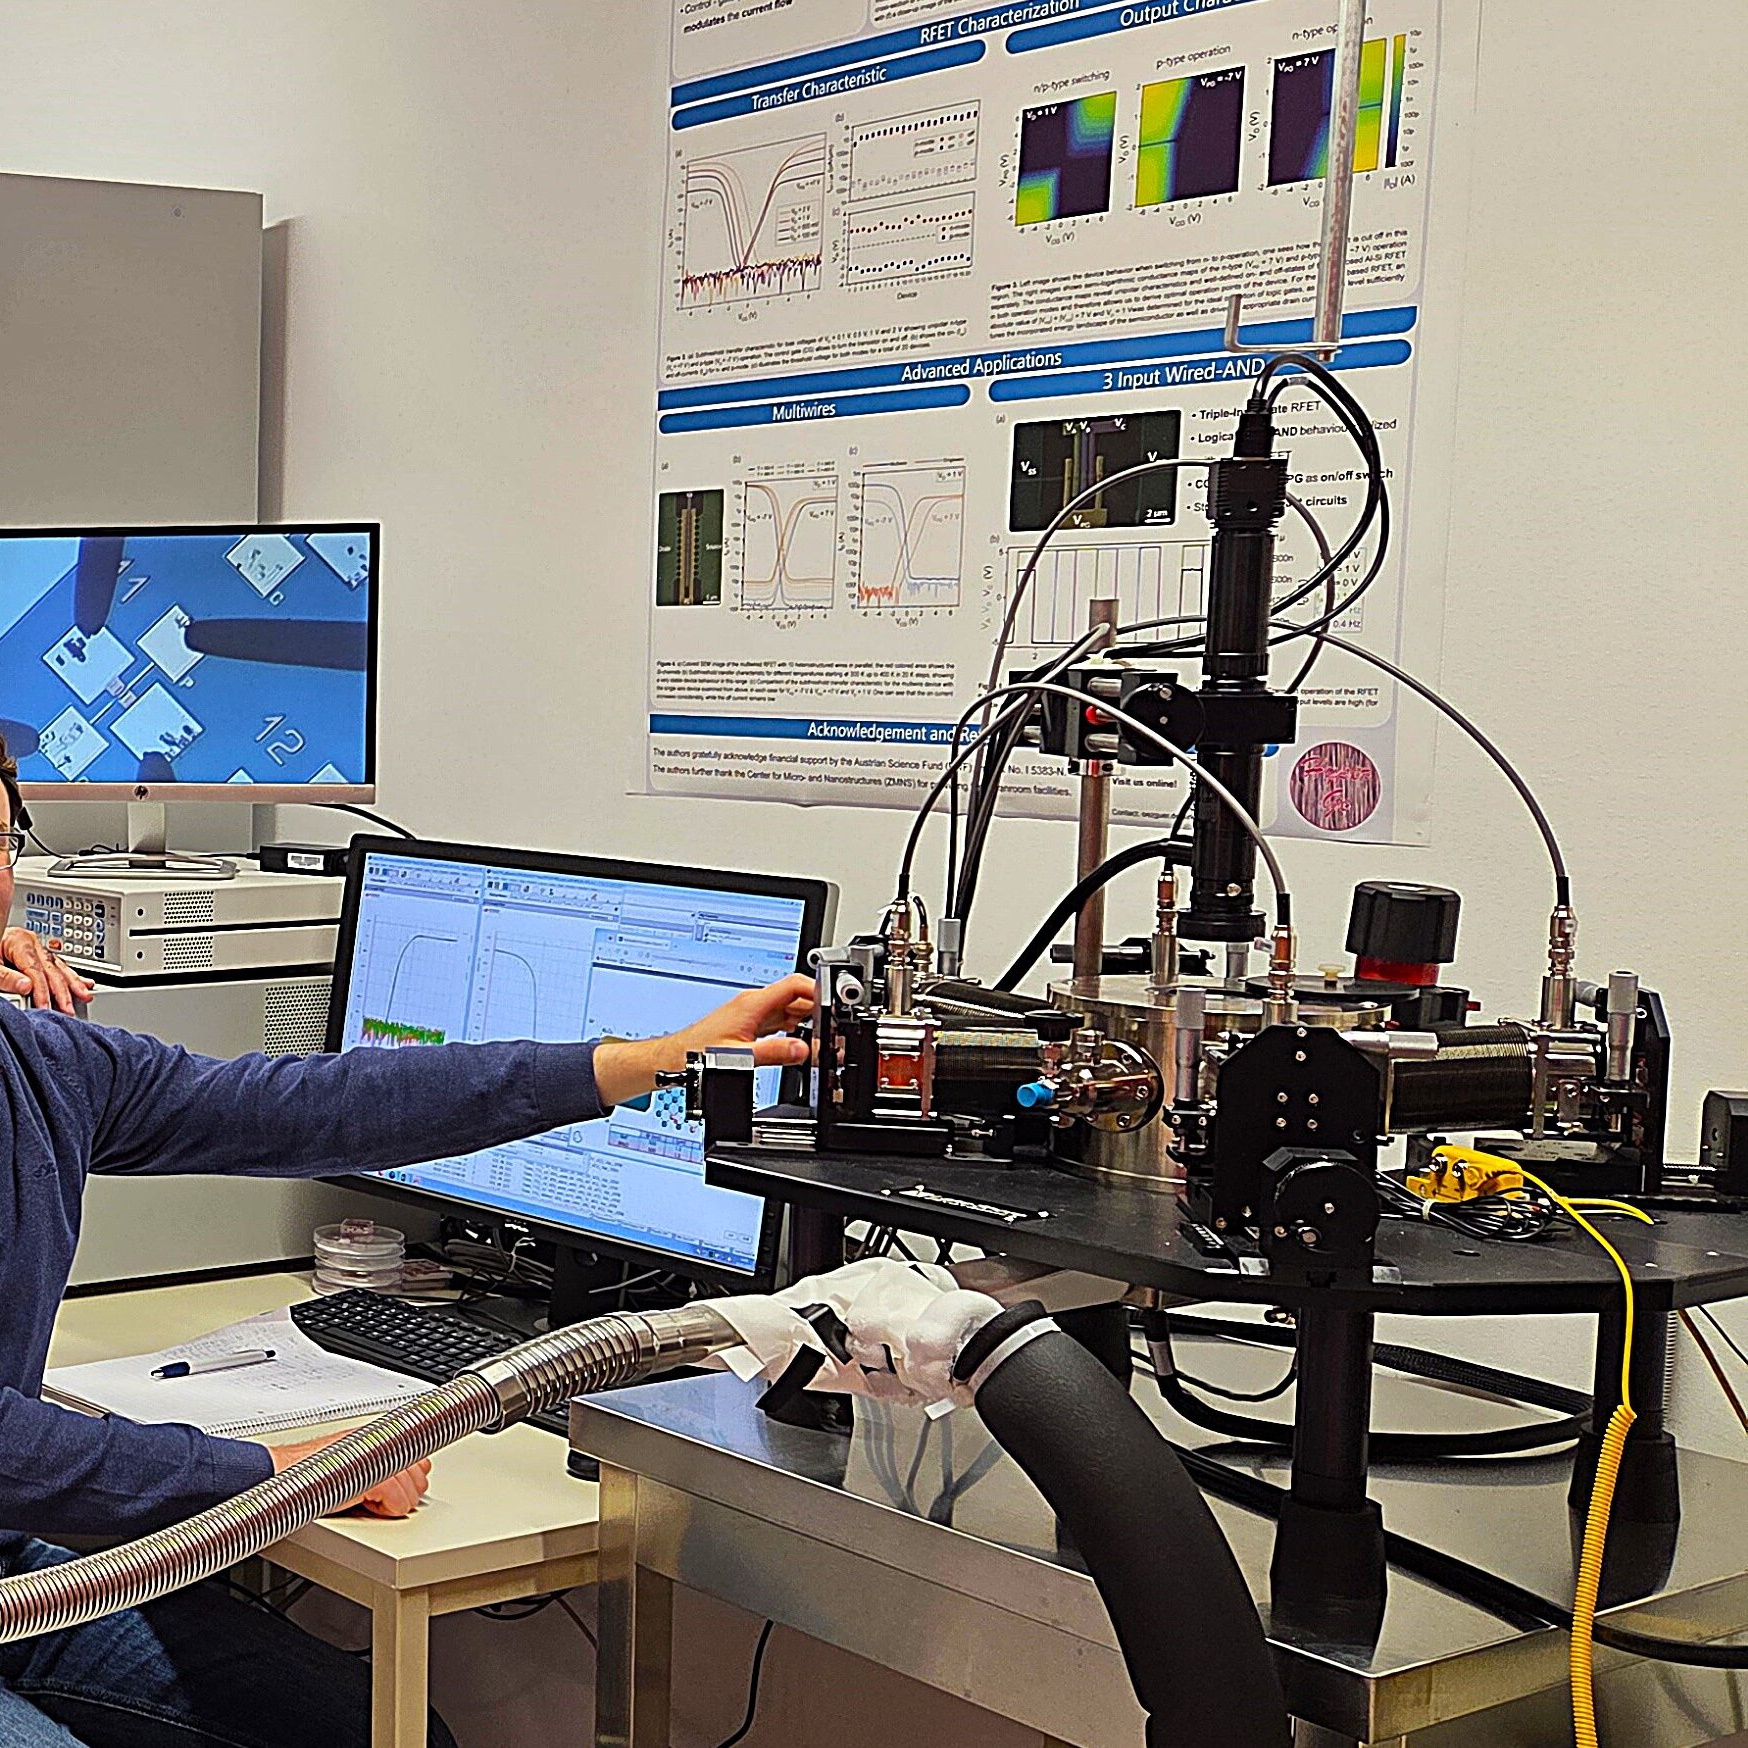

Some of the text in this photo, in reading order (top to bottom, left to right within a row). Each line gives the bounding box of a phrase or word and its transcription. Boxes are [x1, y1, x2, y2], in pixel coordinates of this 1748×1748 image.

[920, 21, 954, 44] RFET
[957, 0, 1079, 33] Characterization
[1120, 3, 1179, 27] Output
[1292, 27, 1324, 41] n-type
[1156, 45, 1230, 70] p-type operation
[1311, 56, 1319, 66] V
[1071, 71, 1110, 87] switching
[1235, 71, 1242, 81] V
[752, 66, 887, 110] Transfer Characteristic
[901, 350, 1062, 381] Advanced Applications
[1102, 357, 1265, 389] 3 Input Wired-AND
[772, 401, 835, 421] Multiwires
[1271, 404, 1288, 413] ate
[1290, 400, 1322, 412] RFET
[1197, 430, 1234, 444] Logica
[1299, 421, 1348, 436] behaviou
[1305, 474, 1317, 483] as
[1320, 470, 1354, 482] on/off
[1354, 468, 1393, 480] swch
[1305, 495, 1348, 507] circuits
[1334, 687, 1342, 695] of
[1356, 687, 1378, 695] RFET
[254, 713, 307, 768] 12
[807, 721, 926, 743] Acknowledgement
[929, 726, 955, 741] and
[653, 746, 665, 755] The
[666, 747, 690, 757] authors
[691, 748, 721, 760] gratefully
[722, 750, 766, 763] acknowledge
[768, 753, 798, 763] financial
[799, 754, 828, 765] support
[828, 755, 838, 766] by
[840, 756, 851, 765] the
[853, 757, 886, 767] Austrian
[887, 759, 920, 769] Science
[922, 760, 942, 770] Fund
[1030, 765, 1065, 776] 5383-N
[652, 763, 664, 773] The
[666, 765, 690, 775] authors
[691, 766, 712, 776] further
[714, 768, 732, 778] thank
[734, 769, 745, 778] the
[746, 769, 770, 780] Center
[772, 771, 782, 780] for
[782, 772, 806, 782] Micro-
[808, 774, 822, 783] and
[823, 774, 882, 785] Nanostructures
[883, 777, 916, 789] (ZMNS)
[916, 779, 928, 788] for
[1032, 784, 1072, 796] facilities.
[1112, 777, 1130, 785] Visit
[1146, 778, 1177, 787] online!
